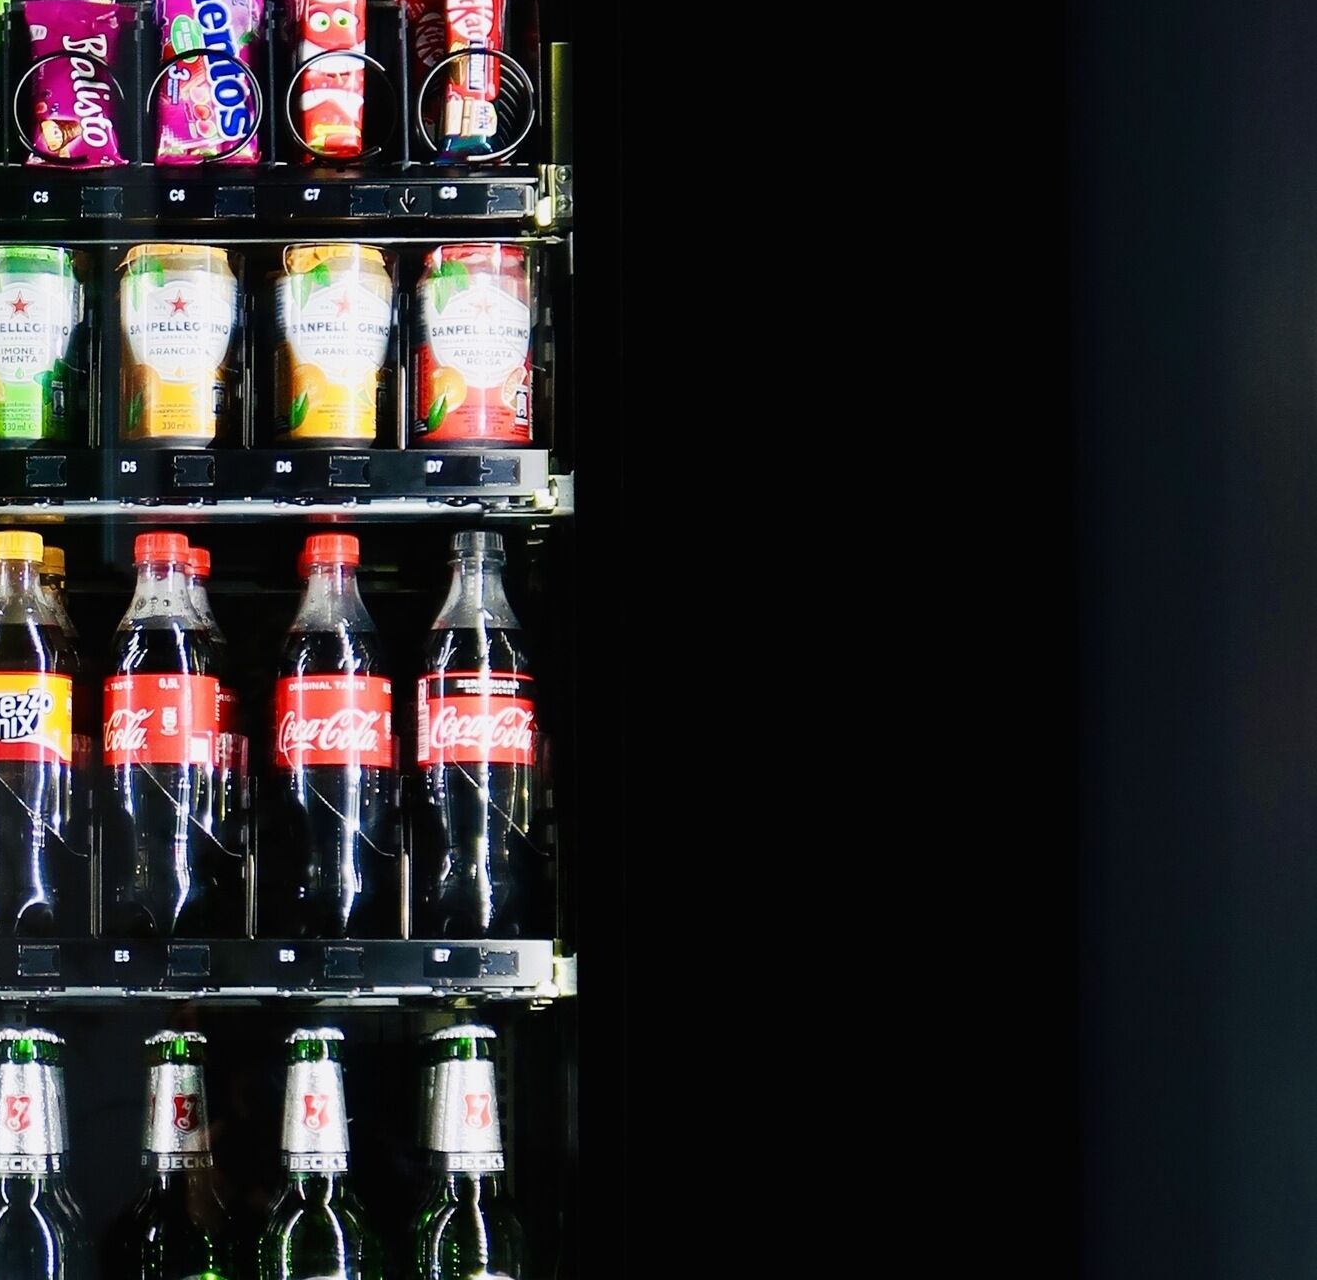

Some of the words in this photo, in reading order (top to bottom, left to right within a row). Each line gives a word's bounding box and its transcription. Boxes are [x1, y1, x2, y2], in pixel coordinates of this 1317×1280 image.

[62, 33, 114, 148] Balisto
[33, 191, 49, 203] C5
[169, 189, 185, 202] C6
[304, 188, 320, 201] C7
[1, 355, 38, 363] MENTA
[3, 422, 16, 431] 330
[17, 422, 26, 431] ml
[121, 461, 137, 473] D5
[276, 460, 292, 473] D6
[426, 460, 443, 474] D7
[279, 708, 382, 752] Coca-Cola
[431, 706, 535, 751] Coca-Cola
[114, 950, 130, 962] E5
[279, 949, 295, 962] E6
[434, 949, 452, 962] E7
